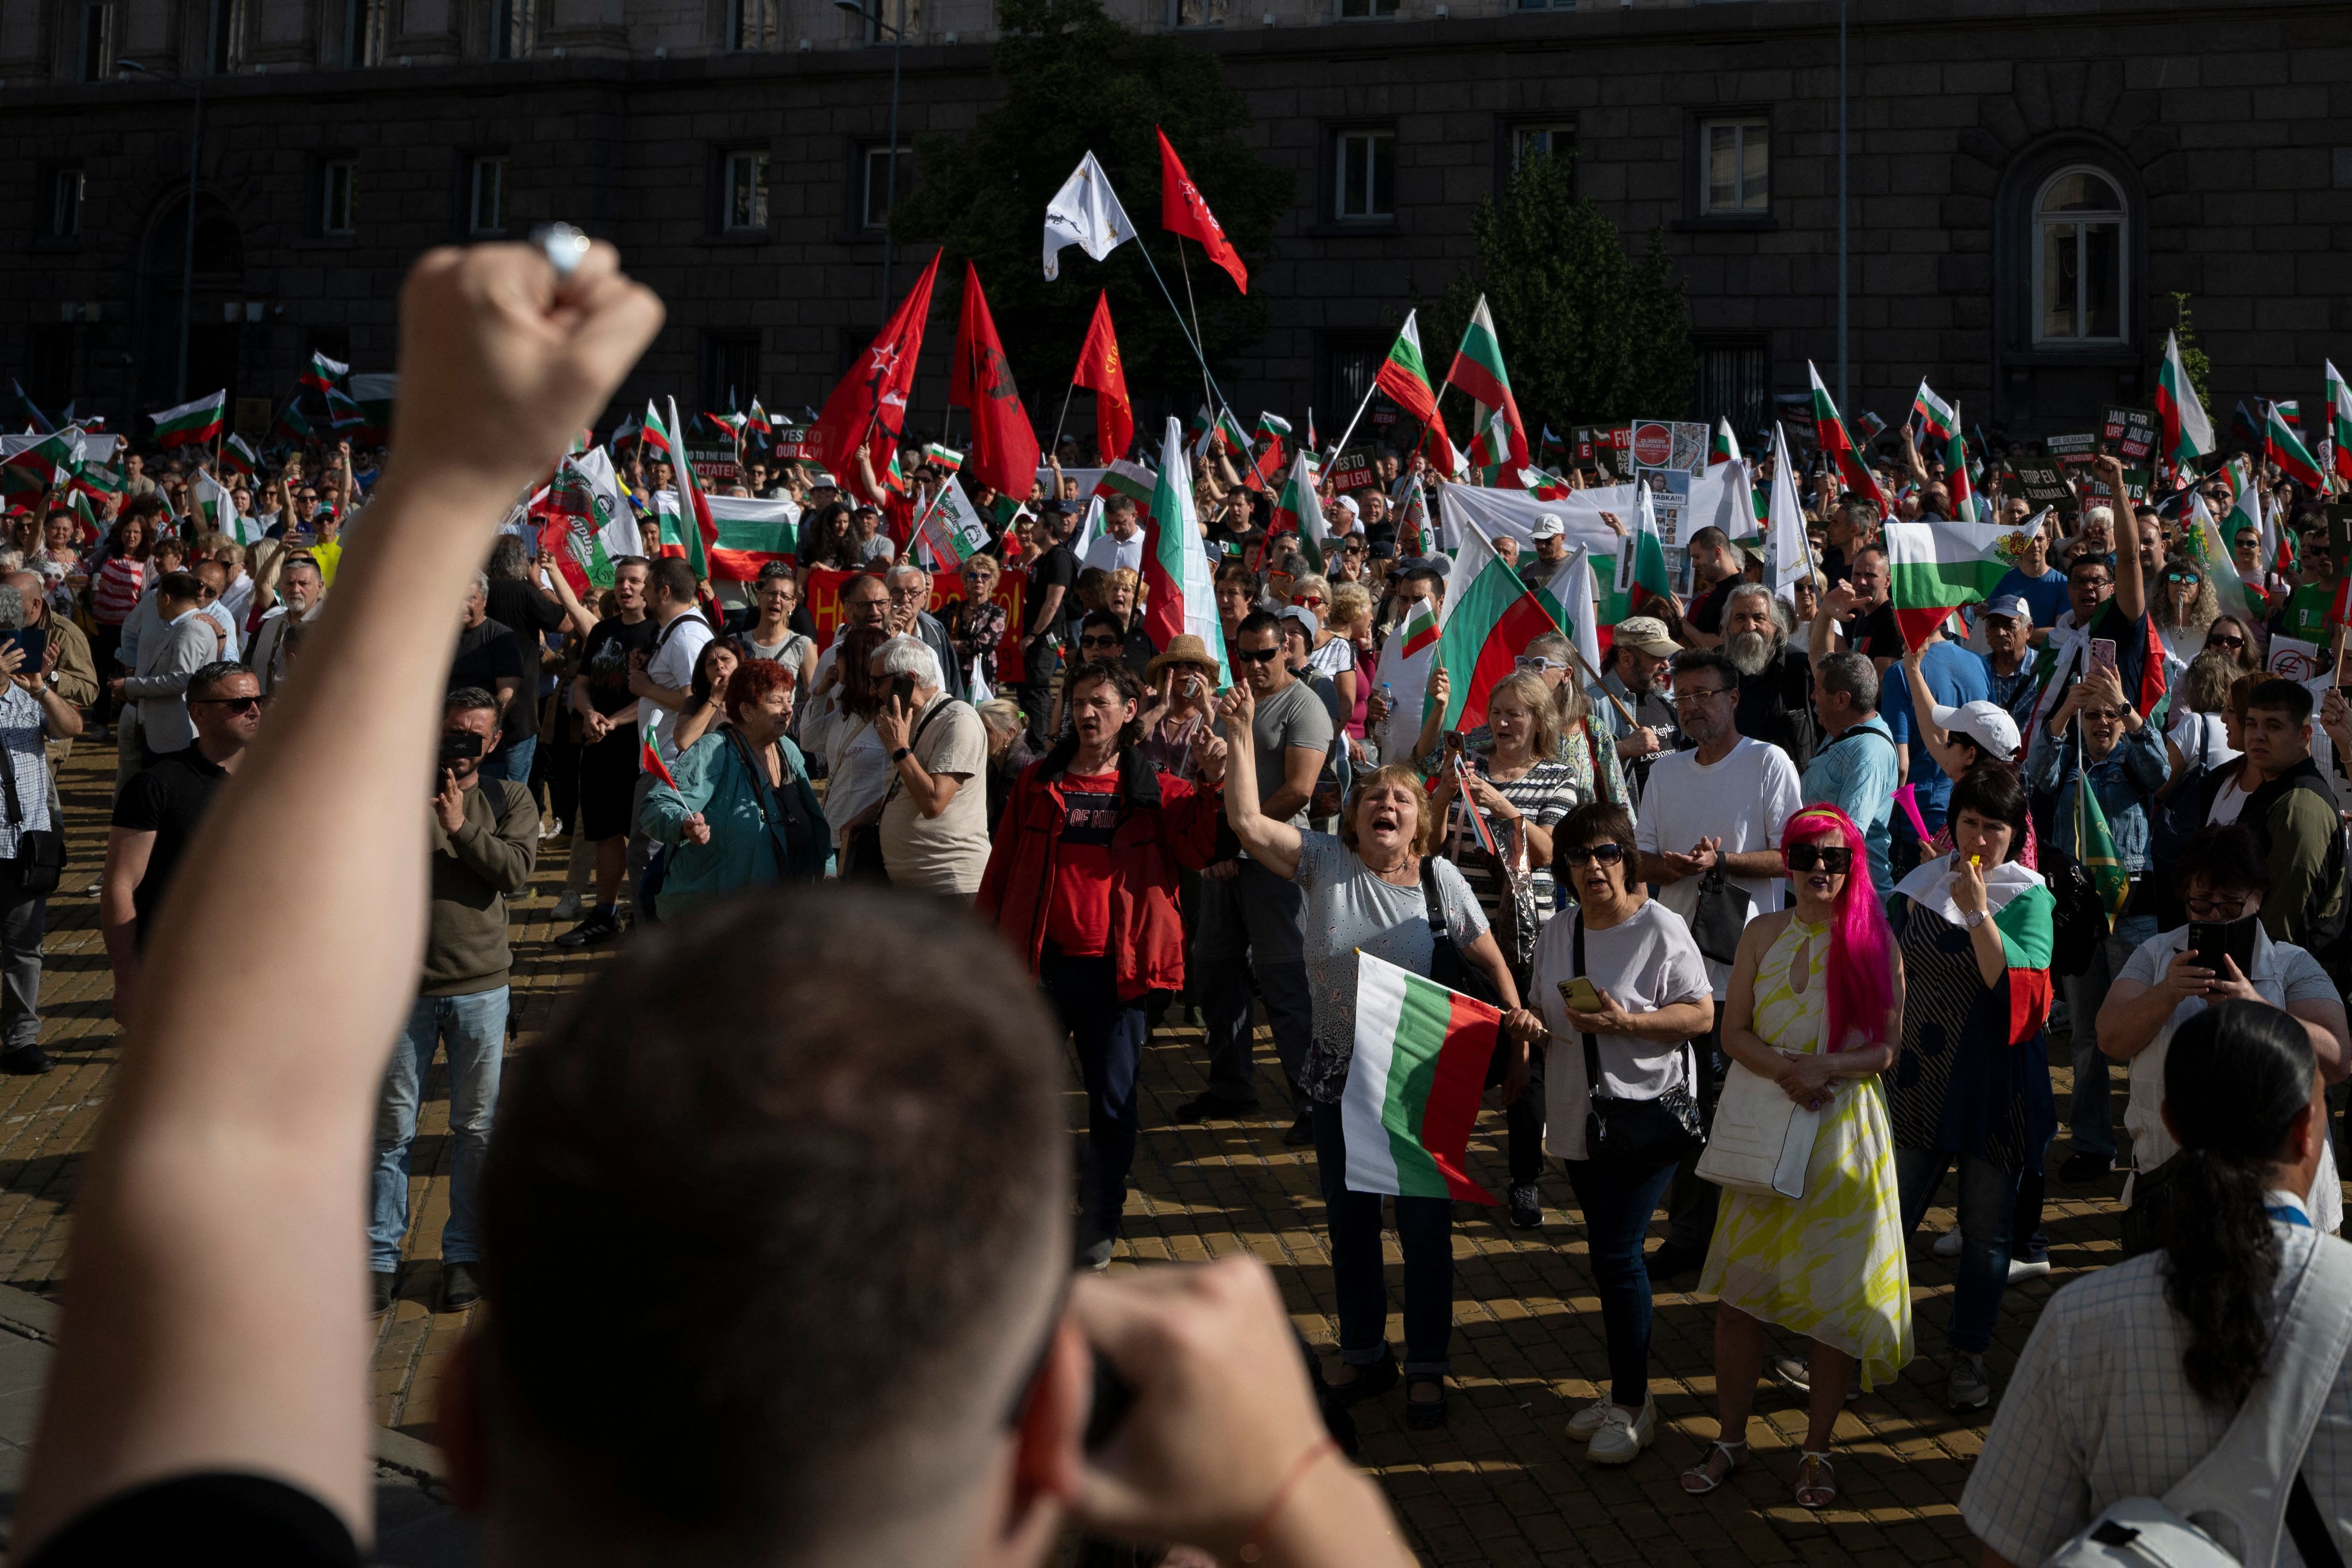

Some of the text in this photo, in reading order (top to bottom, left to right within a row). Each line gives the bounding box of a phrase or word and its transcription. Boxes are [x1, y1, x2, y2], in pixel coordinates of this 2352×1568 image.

[2107, 410, 2125, 424] JAIL
[782, 429, 803, 442] YES
[2127, 426, 2143, 443] JAIL
[776, 444, 797, 458] OUR
[2059, 444, 2091, 453] NATIONAL
[695, 451, 705, 461] TO
[706, 452, 719, 461] THE
[1335, 454, 1365, 472] YES TO
[693, 463, 734, 477] ICTATE!
[2019, 469, 2057, 484] STOP EU
[1335, 474, 1350, 489] OUR
[1349, 470, 1372, 486] LEV!
[1652, 494, 1682, 502] ТАВКА!!!
[2133, 485, 2143, 498] IS
[1070, 809, 1090, 827] OF
